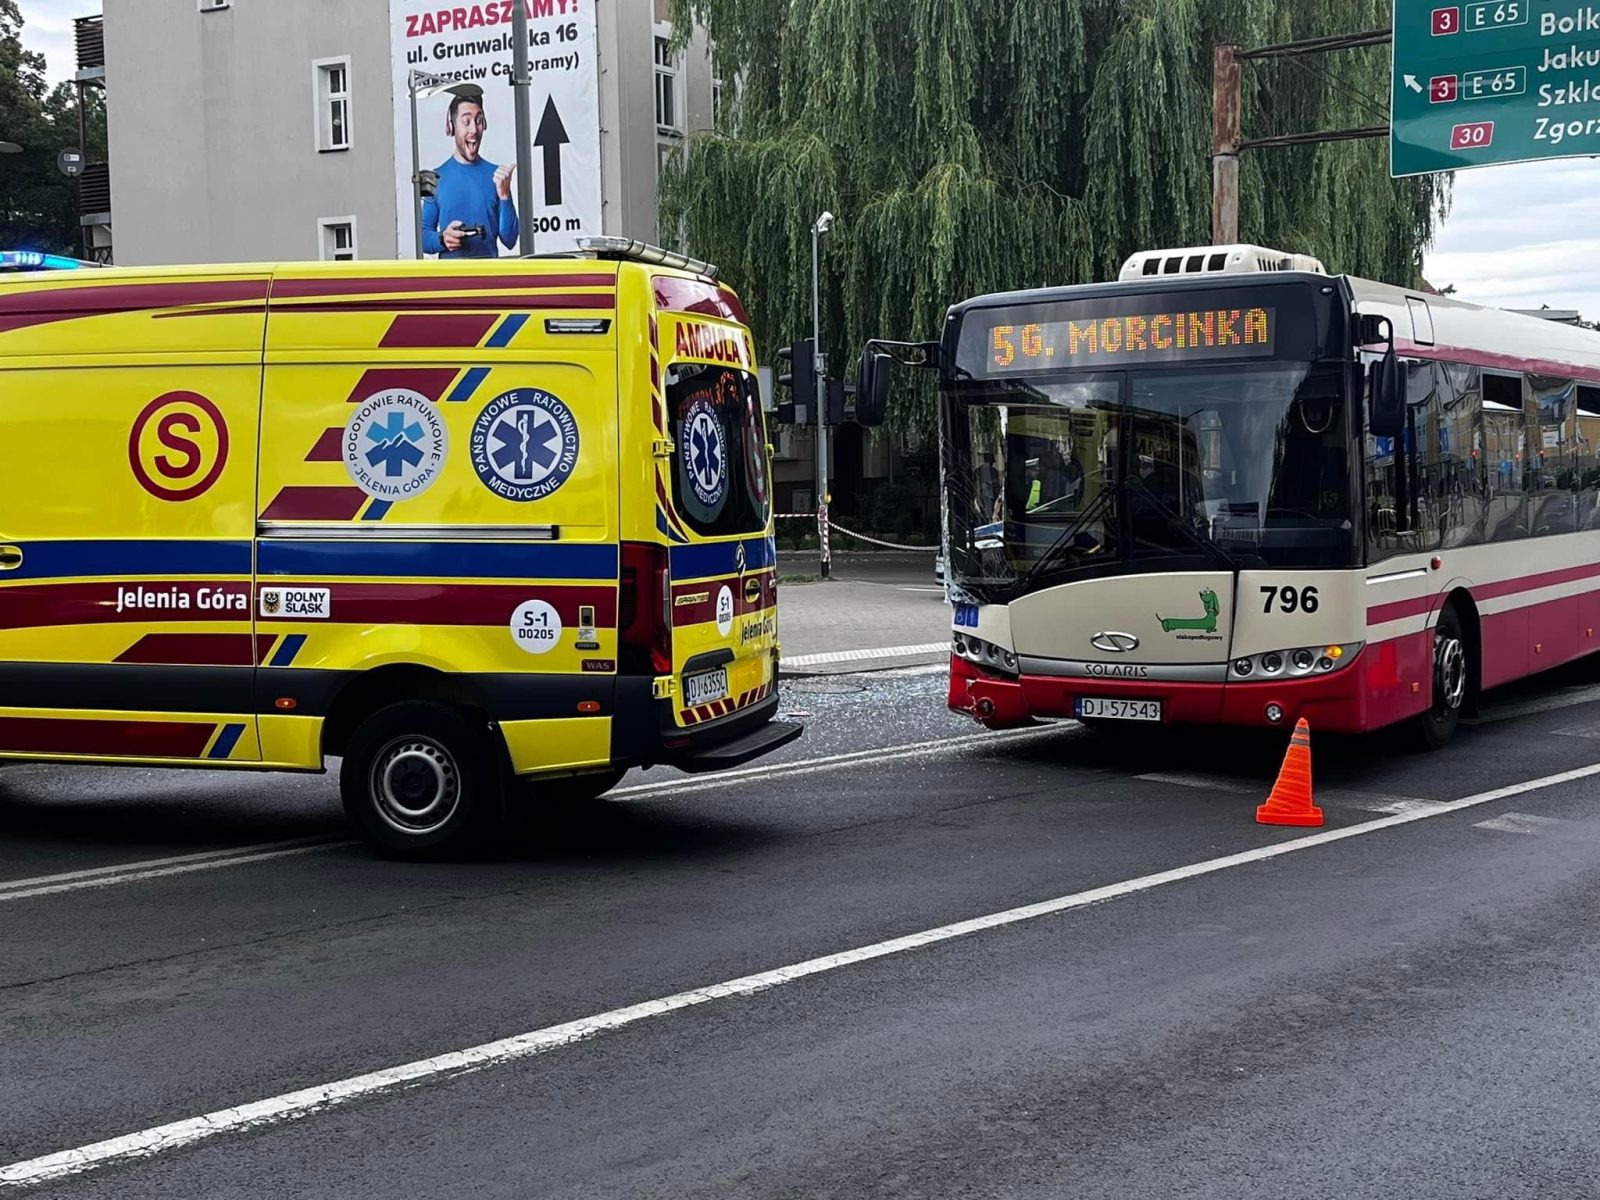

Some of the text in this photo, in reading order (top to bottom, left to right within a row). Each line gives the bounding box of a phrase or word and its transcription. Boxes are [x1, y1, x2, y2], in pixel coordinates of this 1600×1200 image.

[1439, 13, 1451, 30] 3
[1475, 3, 1518, 26] E 65
[1541, 7, 1600, 36] Bolk
[407, 22, 578, 64] ul. Grunwalka 16
[491, 51, 579, 76] Caoramy)
[1538, 45, 1600, 72] Jaku
[1438, 81, 1449, 98] 3
[1472, 72, 1515, 95] E 65
[1459, 127, 1484, 144] 30
[533, 216, 580, 233] 500 m
[676, 321, 752, 367] AMBULAS
[993, 308, 1267, 366] 5 G. MORCINKA
[348, 394, 442, 461] POGOTOWIE RATUNKOWE
[472, 392, 576, 473] PAŃSTWOWE RATOWNICTWO
[154, 412, 201, 479] S
[354, 467, 434, 495] JELENIA GÓRA
[488, 476, 560, 499] MEDYCZNE
[116, 586, 247, 613] Jelenia Góra
[285, 591, 326, 603] DOLNY
[285, 601, 323, 614] ŚLĄSK
[1260, 585, 1319, 614] 796
[523, 611, 548, 627] S-1
[586, 661, 611, 670] WAS
[1085, 664, 1148, 677] SOLARIS
[690, 677, 701, 699] DJ
[1084, 699, 1158, 719] DJ 57543
